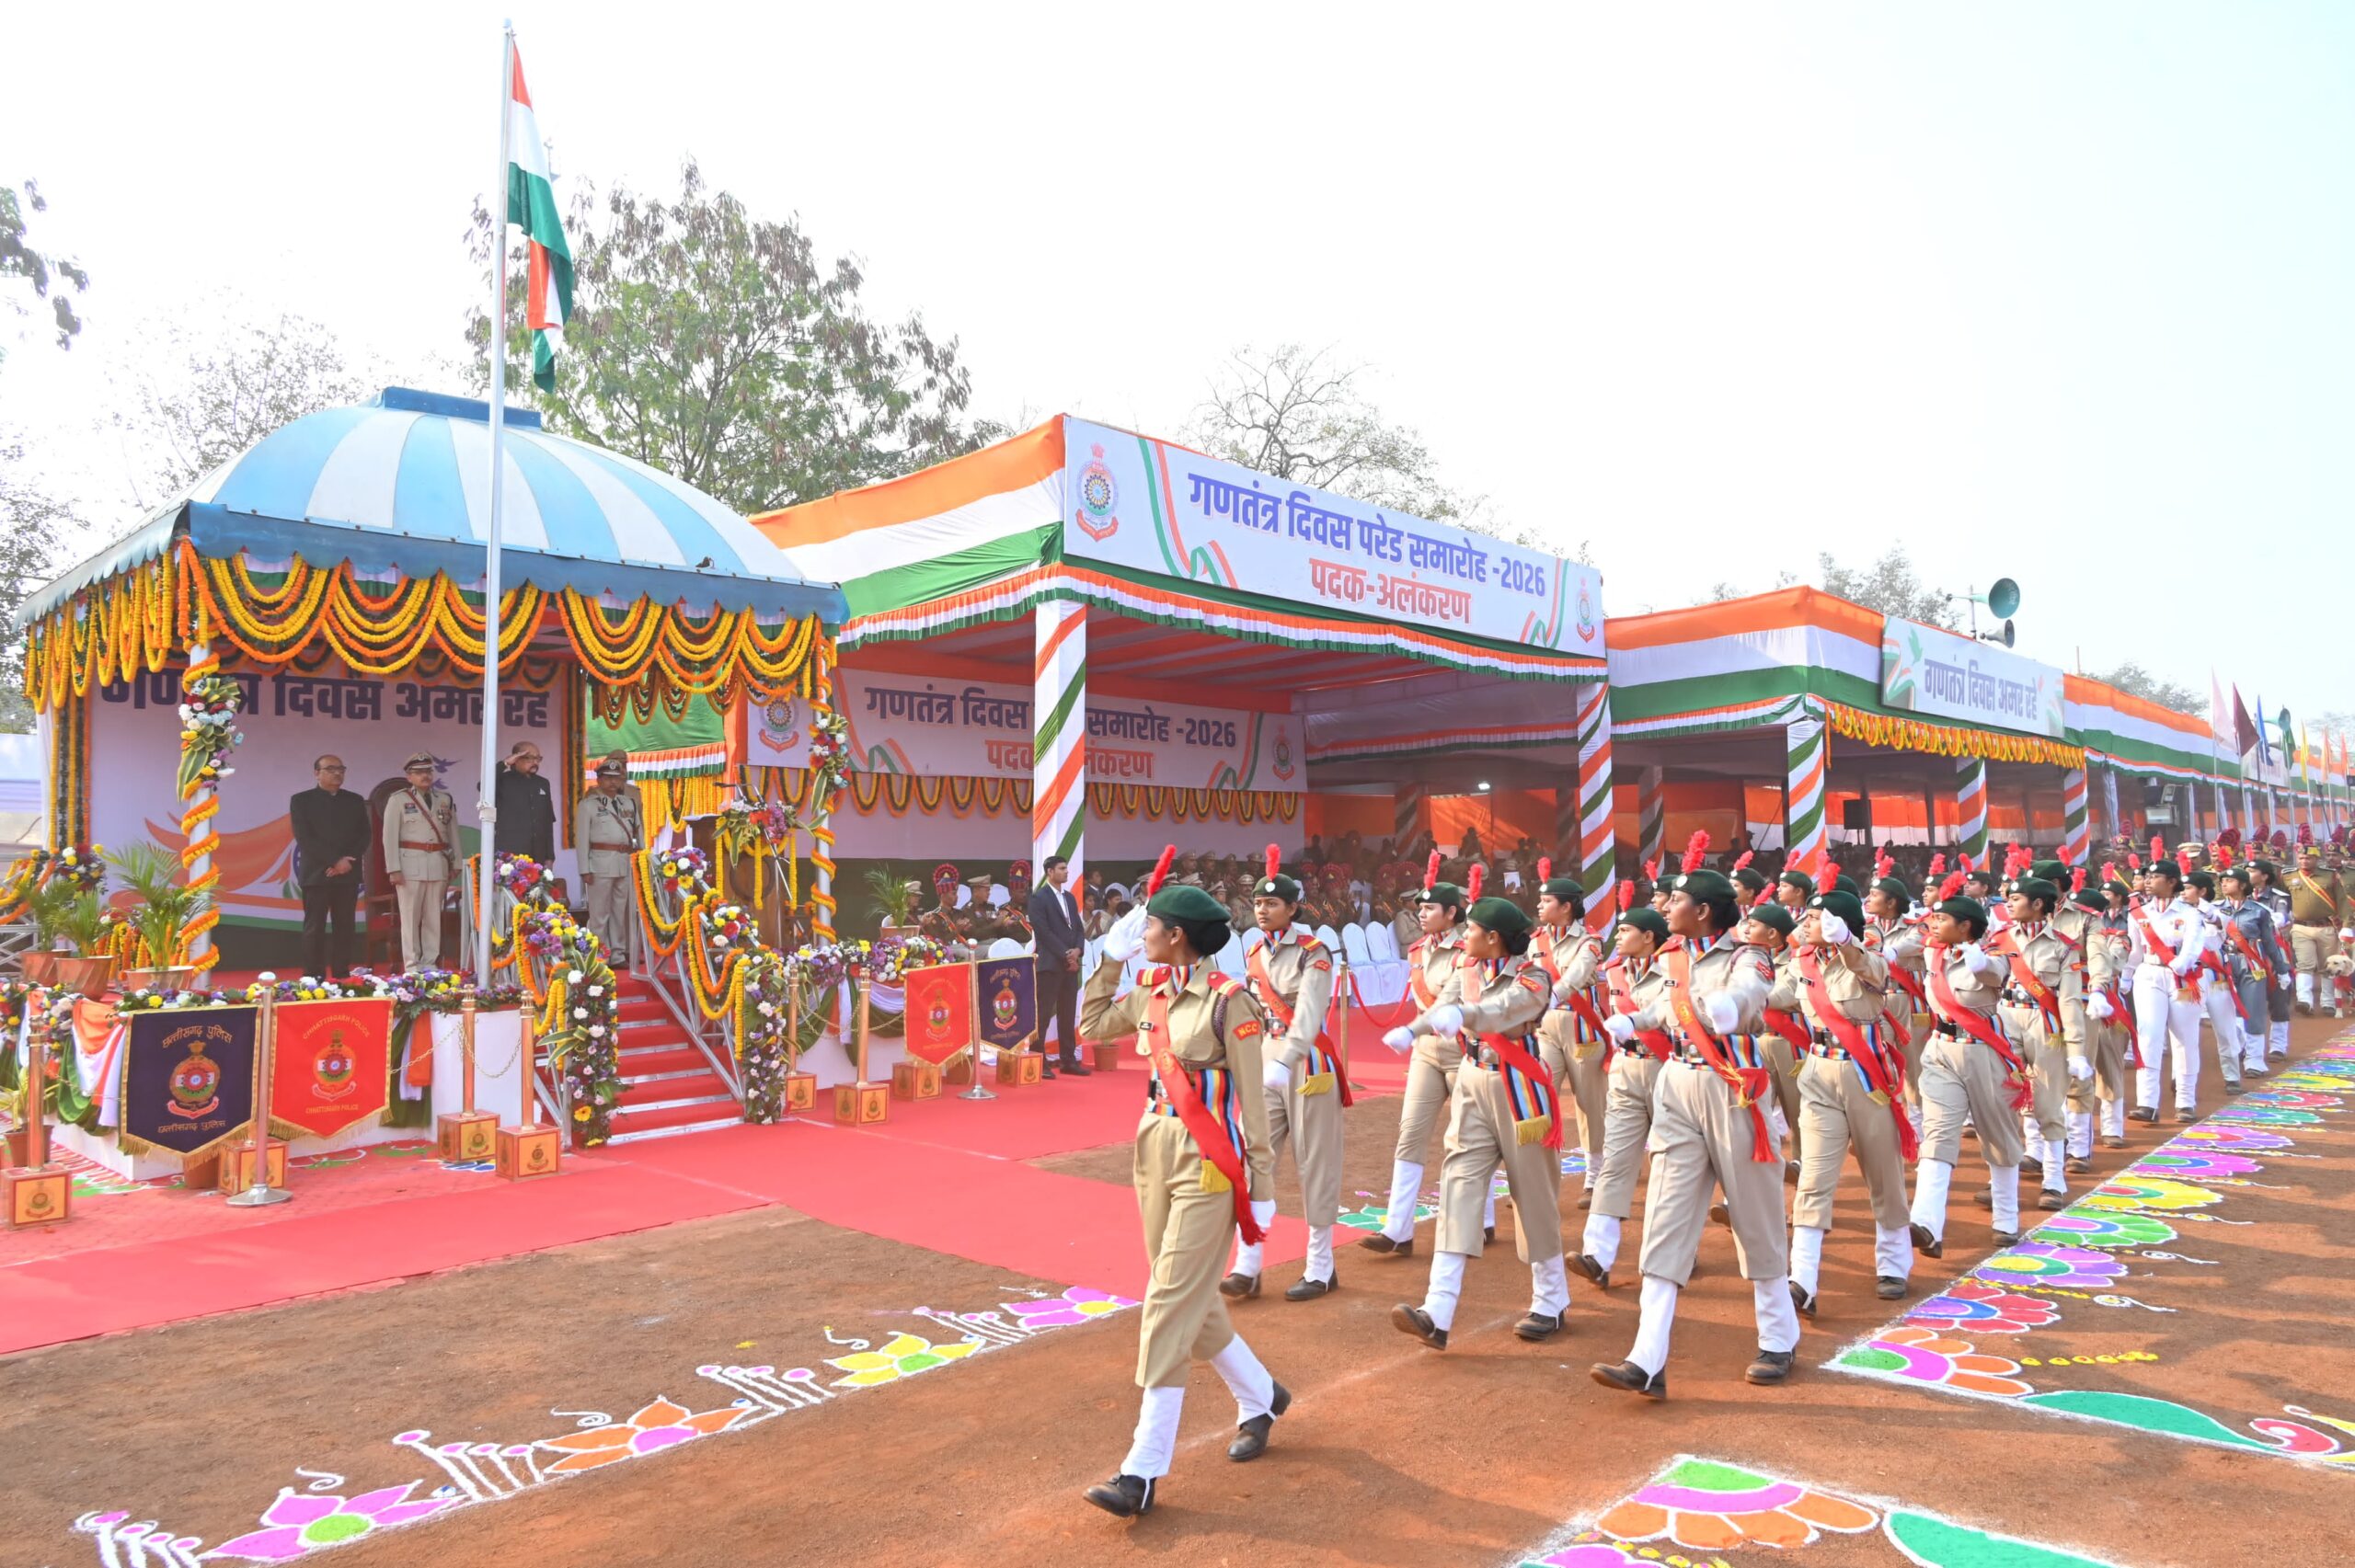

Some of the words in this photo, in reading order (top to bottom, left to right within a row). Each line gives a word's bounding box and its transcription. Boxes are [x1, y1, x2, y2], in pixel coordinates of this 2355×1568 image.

[1188, 473, 1282, 533] गणतंत्र
[1285, 490, 1354, 551] दिवस
[1357, 513, 1404, 563] परेड
[1407, 537, 1488, 583] समारोह
[1492, 556, 1545, 597] -2026
[1309, 557, 1472, 624] पदक-अलंकरण
[864, 683, 957, 724] गणतंत्र
[960, 687, 1029, 729] दिवस
[1086, 705, 1171, 742] समारोह
[1176, 718, 1236, 748] -2026
[1924, 654, 1966, 705] गणतंत्र
[1968, 658, 1996, 712] दिवस
[1998, 678, 2024, 717] अमर
[2025, 676, 2038, 721] रहे
[206, 1024, 233, 1044] पुलिस
[350, 1017, 370, 1038] POLICE
[1238, 1022, 1258, 1036] NCC
